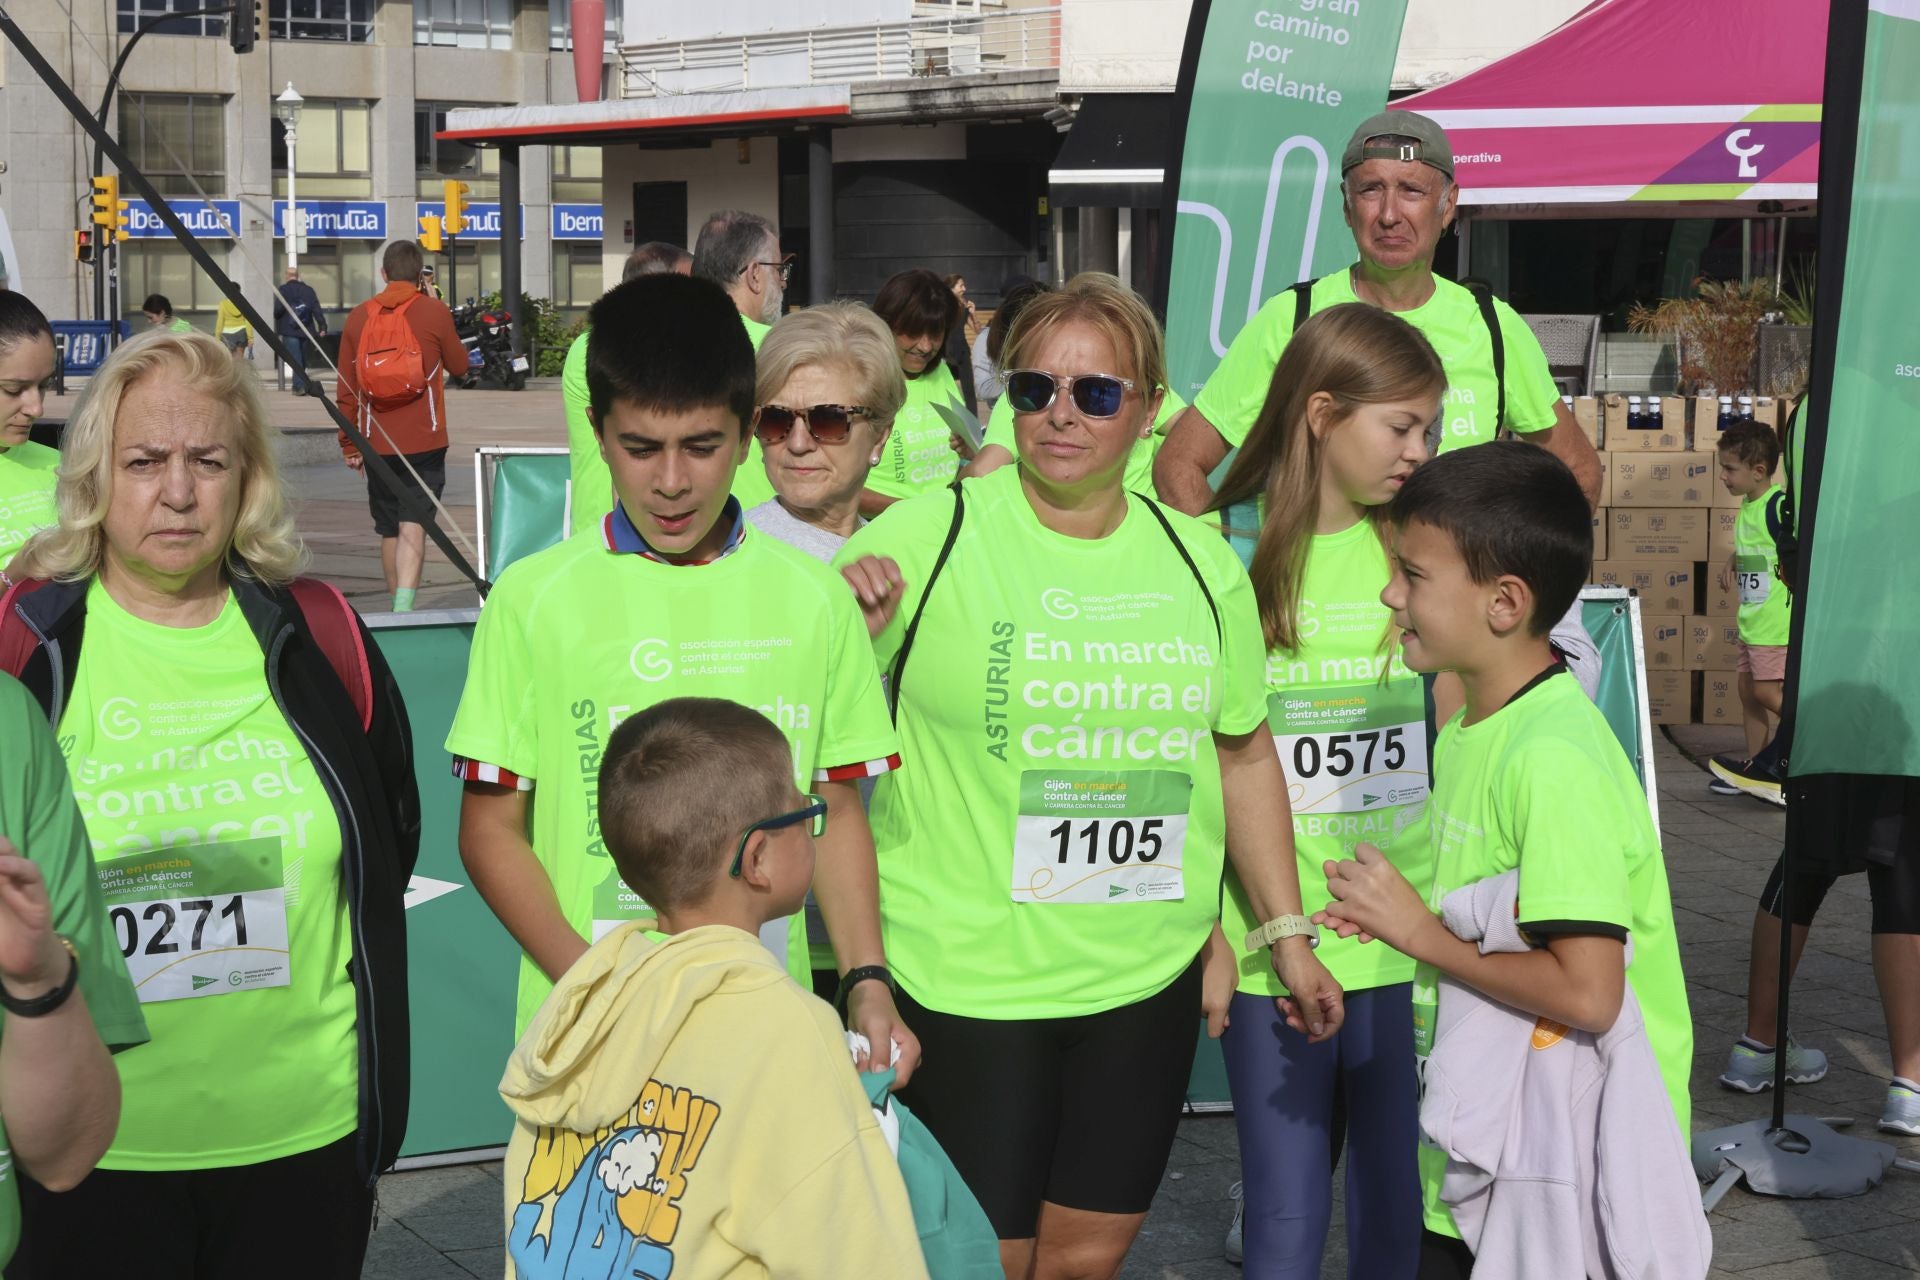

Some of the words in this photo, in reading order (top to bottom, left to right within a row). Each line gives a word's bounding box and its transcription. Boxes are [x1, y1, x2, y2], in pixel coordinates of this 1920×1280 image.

[1254, 10, 1350, 46] camino
[1246, 40, 1294, 64] por
[1241, 67, 1342, 107] delante
[1451, 410, 1479, 436] el
[680, 652, 719, 663] contra
[721, 651, 732, 662] el
[1025, 631, 1073, 662] En
[1083, 635, 1214, 668] marcha
[681, 667, 697, 677] en
[699, 664, 746, 676] Asturias
[1265, 655, 1310, 685] En
[984, 620, 1016, 763] ASTURIAS
[1021, 674, 1173, 711] contra
[1181, 674, 1211, 714] el
[1284, 699, 1312, 711] Gijón
[1313, 700, 1327, 709] en
[1285, 709, 1319, 720] contra
[1320, 708, 1332, 718] el
[1333, 706, 1367, 718] cáncer
[1021, 713, 1211, 761] cáncer
[1293, 727, 1406, 779] 0575
[250, 759, 304, 799] el
[1043, 779, 1072, 792] Gijón
[1074, 783, 1087, 791] en
[1043, 791, 1079, 801] contra
[1081, 791, 1091, 801] el
[1092, 791, 1127, 801] cáncer
[1293, 813, 1389, 837] ABORAL
[1049, 819, 1164, 865] 1105
[97, 868, 124, 881] ijón
[126, 865, 142, 875] en
[144, 857, 193, 872] marcha
[101, 877, 134, 890] ontra
[136, 873, 150, 884] el
[151, 870, 193, 883] cáncer
[131, 884, 158, 893] CONTRA
[109, 895, 248, 960] 0271
